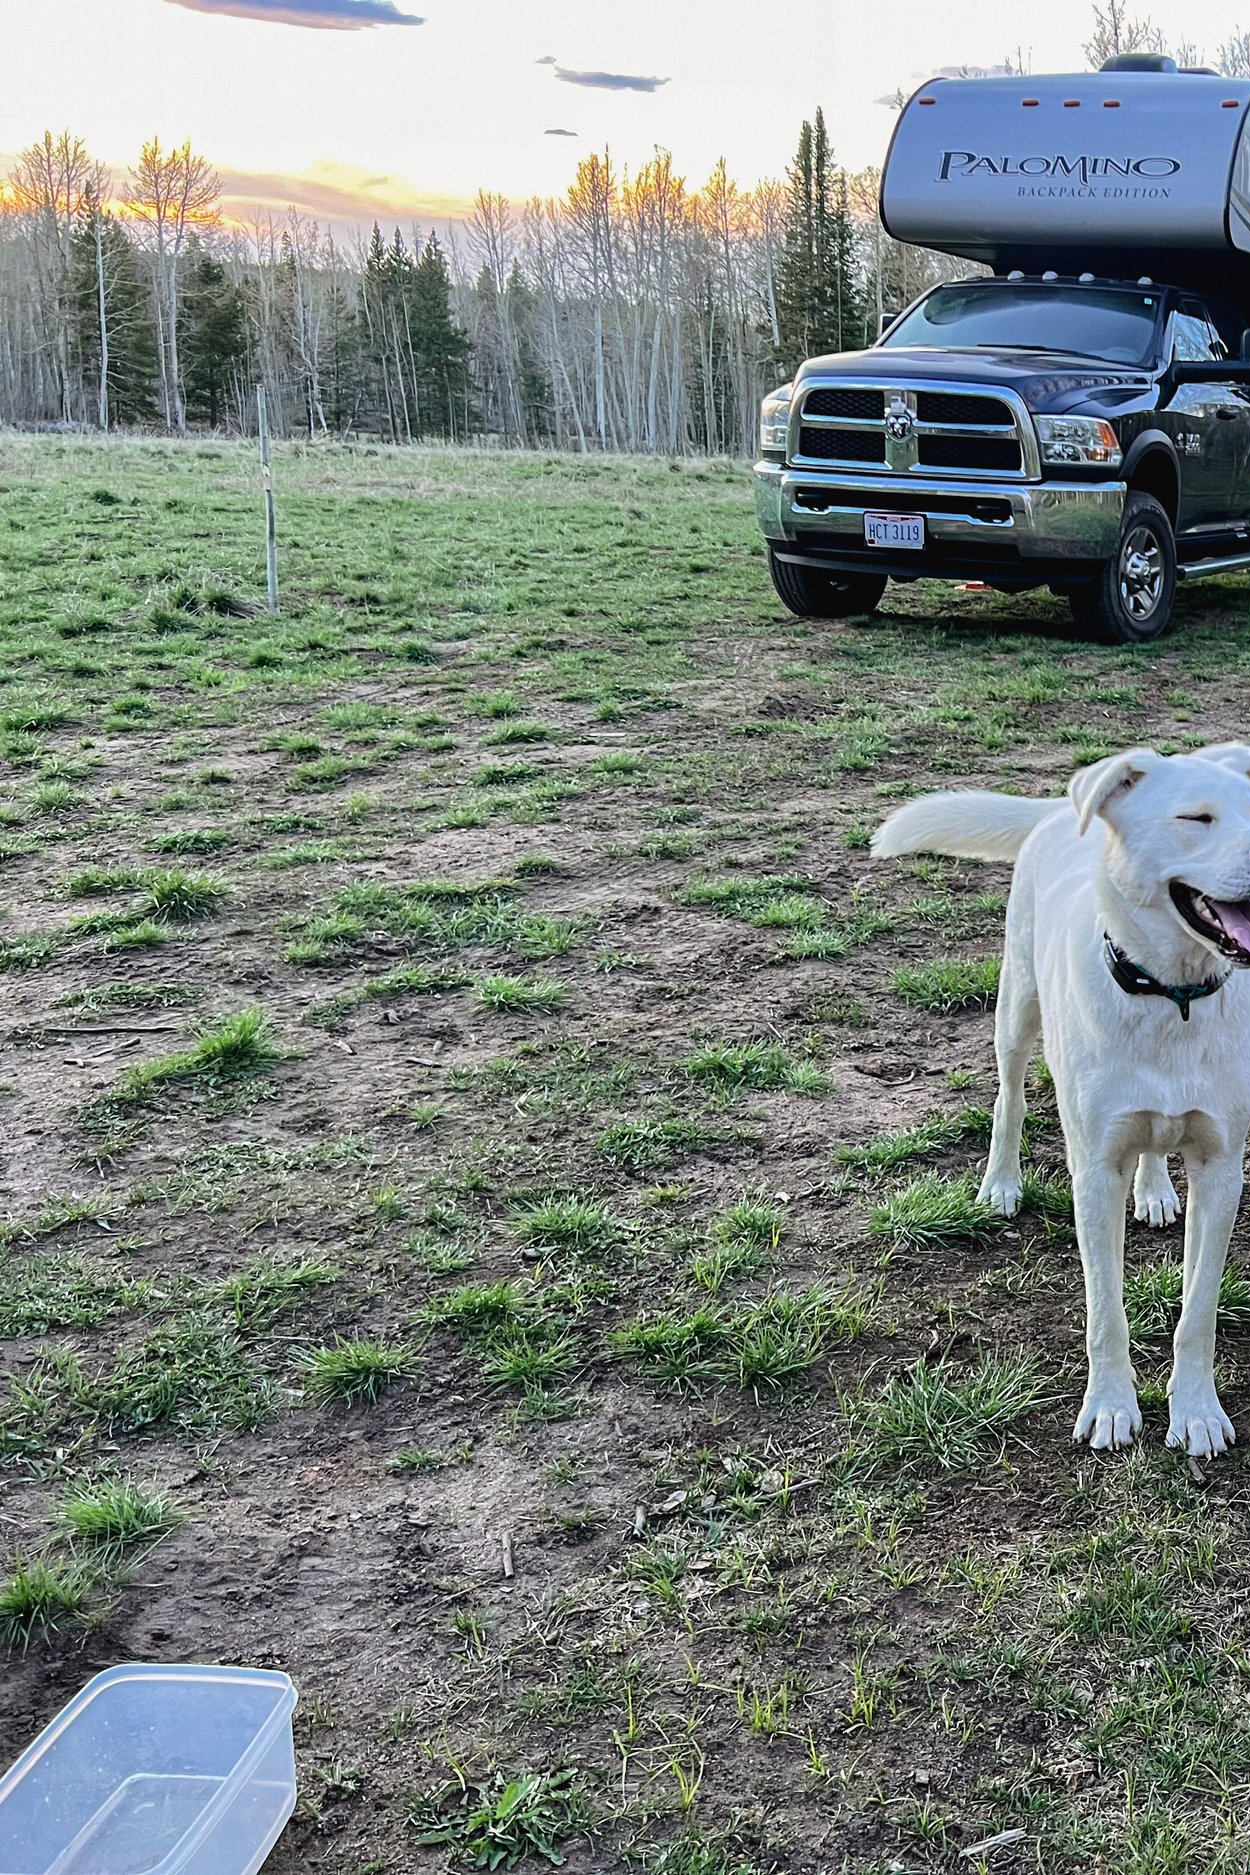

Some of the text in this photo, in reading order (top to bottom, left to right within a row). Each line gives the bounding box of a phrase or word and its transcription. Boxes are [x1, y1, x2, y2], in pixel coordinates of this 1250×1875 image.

[935, 151, 1182, 186] PALOMINO
[1017, 186, 1171, 199] BACKPACK EDITION
[869, 523, 919, 541] HCT 3119
